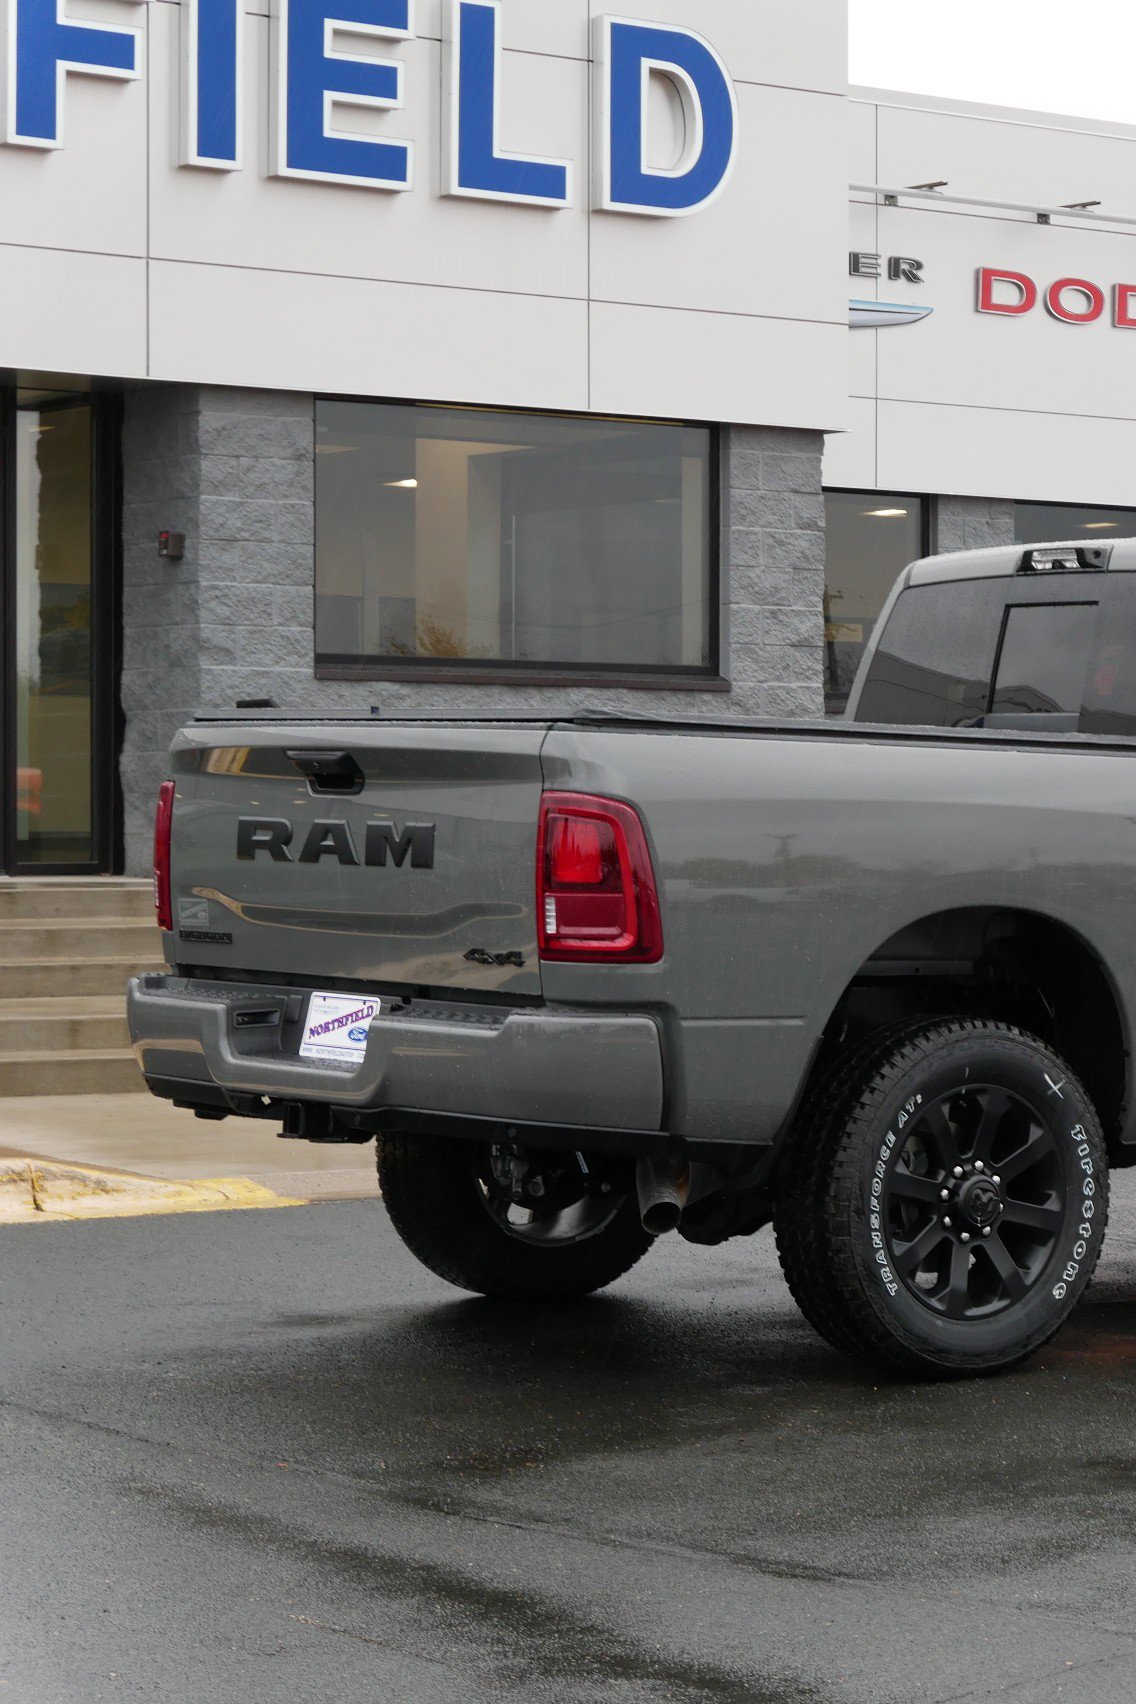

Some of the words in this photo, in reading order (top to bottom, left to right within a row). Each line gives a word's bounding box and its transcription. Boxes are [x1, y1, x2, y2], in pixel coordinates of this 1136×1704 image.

[236, 815, 437, 869] RAM
[308, 1004, 375, 1040] NORTHFIELD
[869, 1130, 899, 1297] TRANSFORCE
